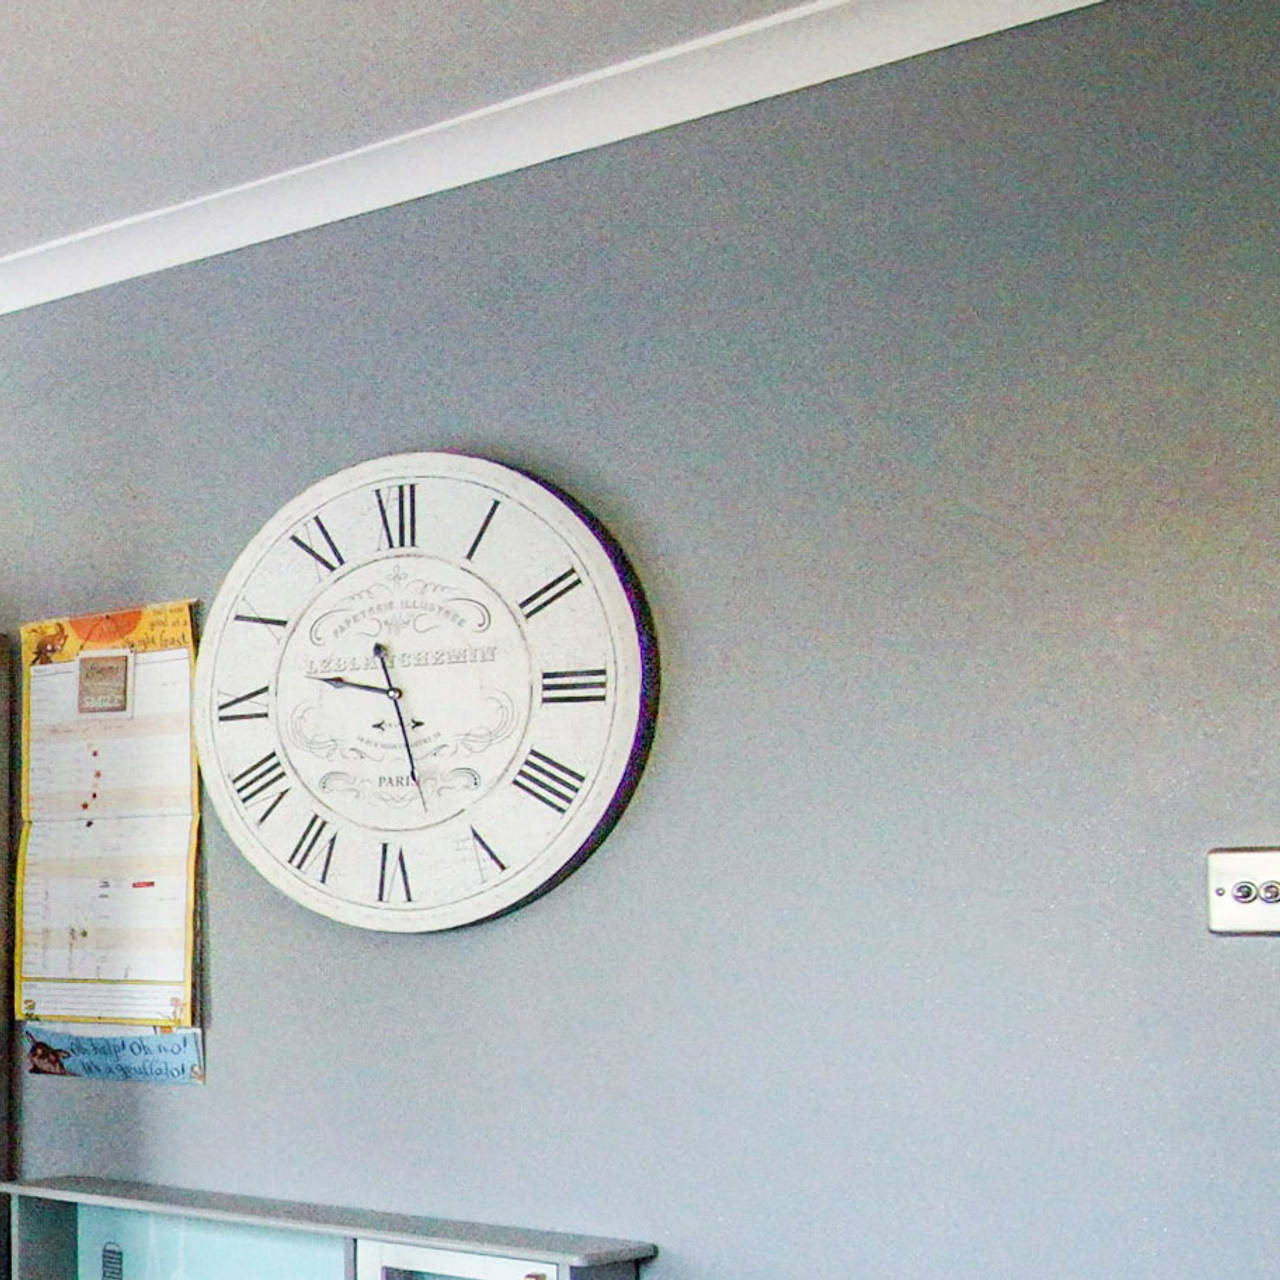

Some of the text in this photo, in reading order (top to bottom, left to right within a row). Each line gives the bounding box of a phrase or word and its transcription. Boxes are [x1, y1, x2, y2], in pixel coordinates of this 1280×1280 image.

[541, 668, 606, 703] III
[129, 1037, 153, 1057] Oh
[158, 1036, 187, 1056] no!
